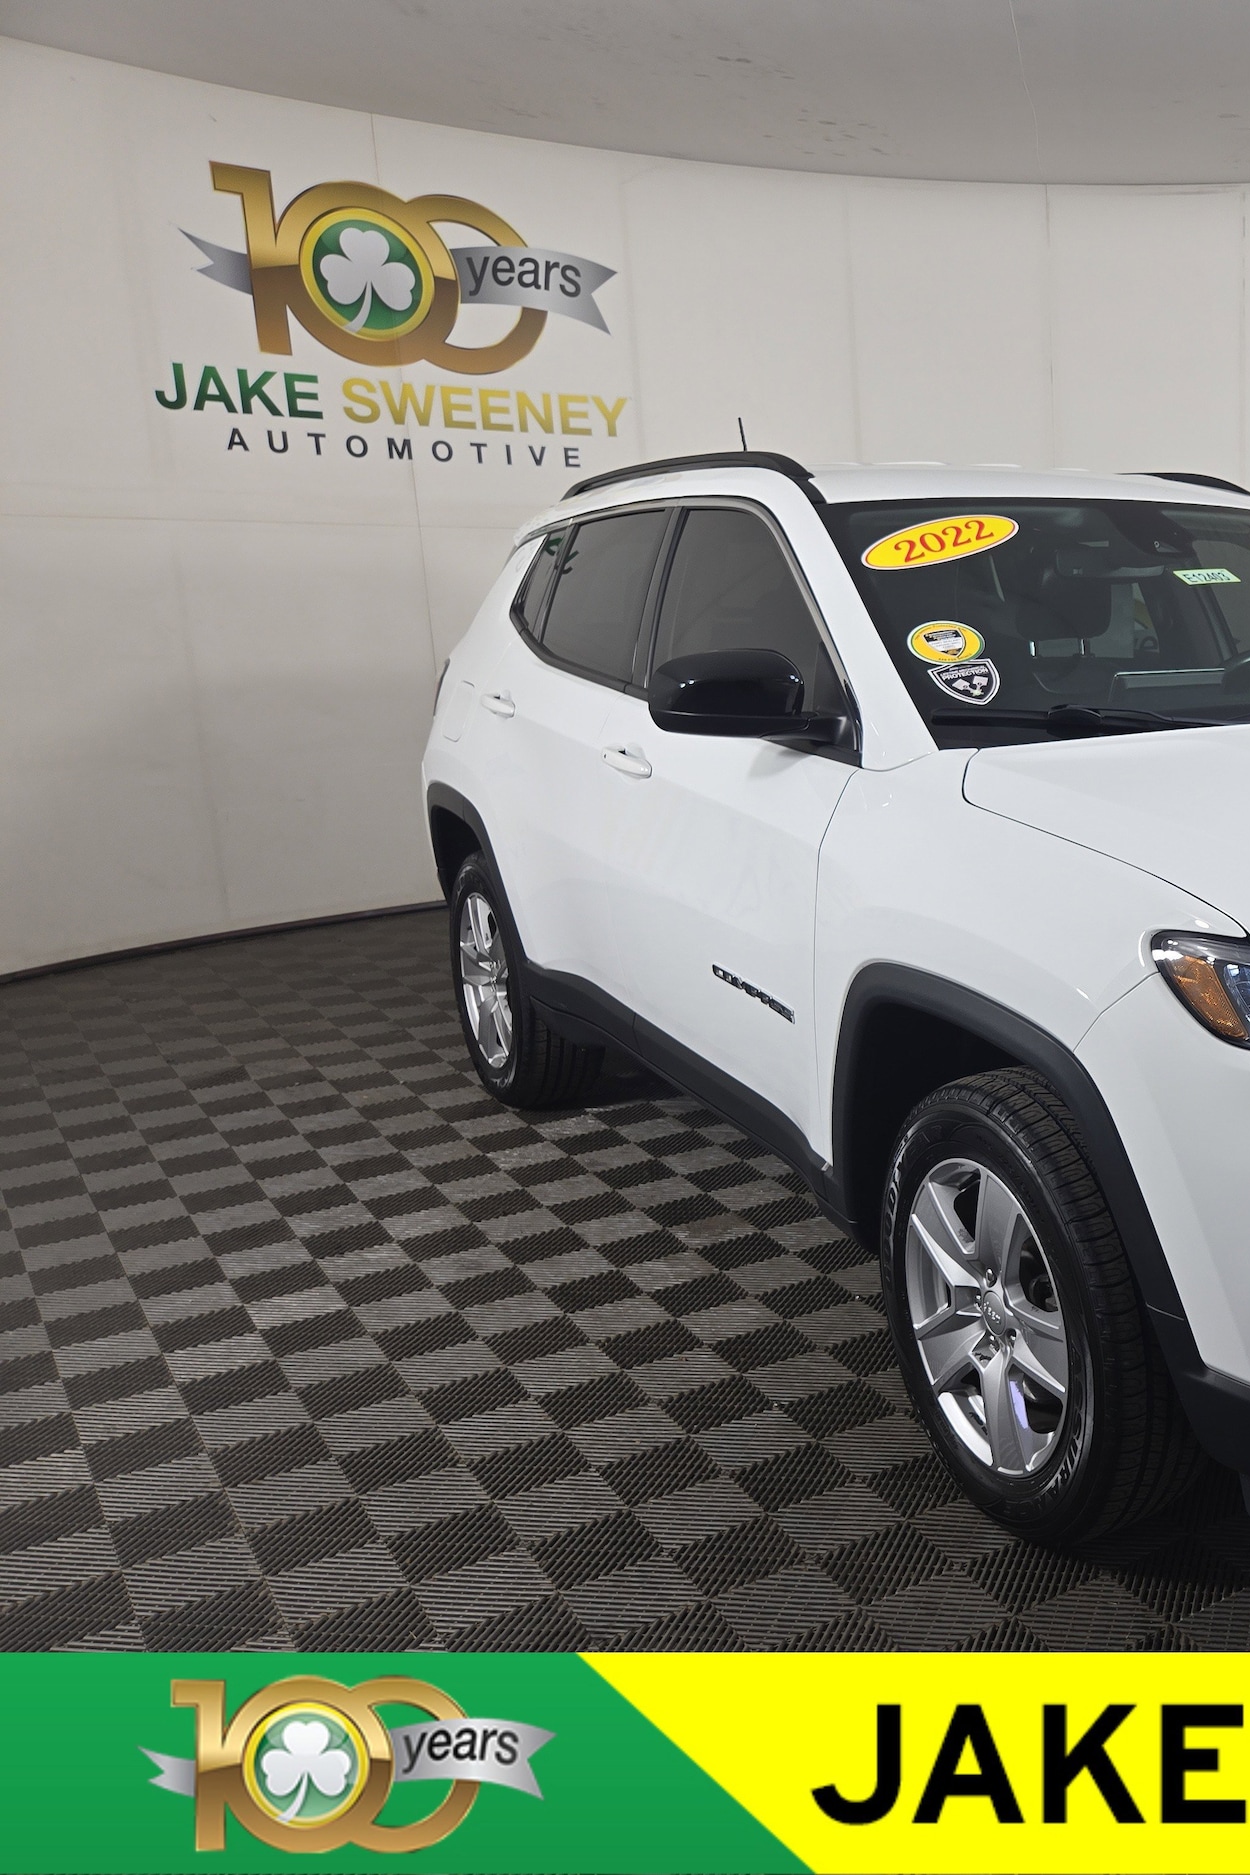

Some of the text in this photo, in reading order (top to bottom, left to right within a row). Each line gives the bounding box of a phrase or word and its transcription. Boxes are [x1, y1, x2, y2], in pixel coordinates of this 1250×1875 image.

[465, 253, 583, 298] years
[154, 362, 630, 438] JAKE SWEENEY
[226, 427, 582, 469] AUTOMOTIVE
[893, 519, 995, 564] 2022
